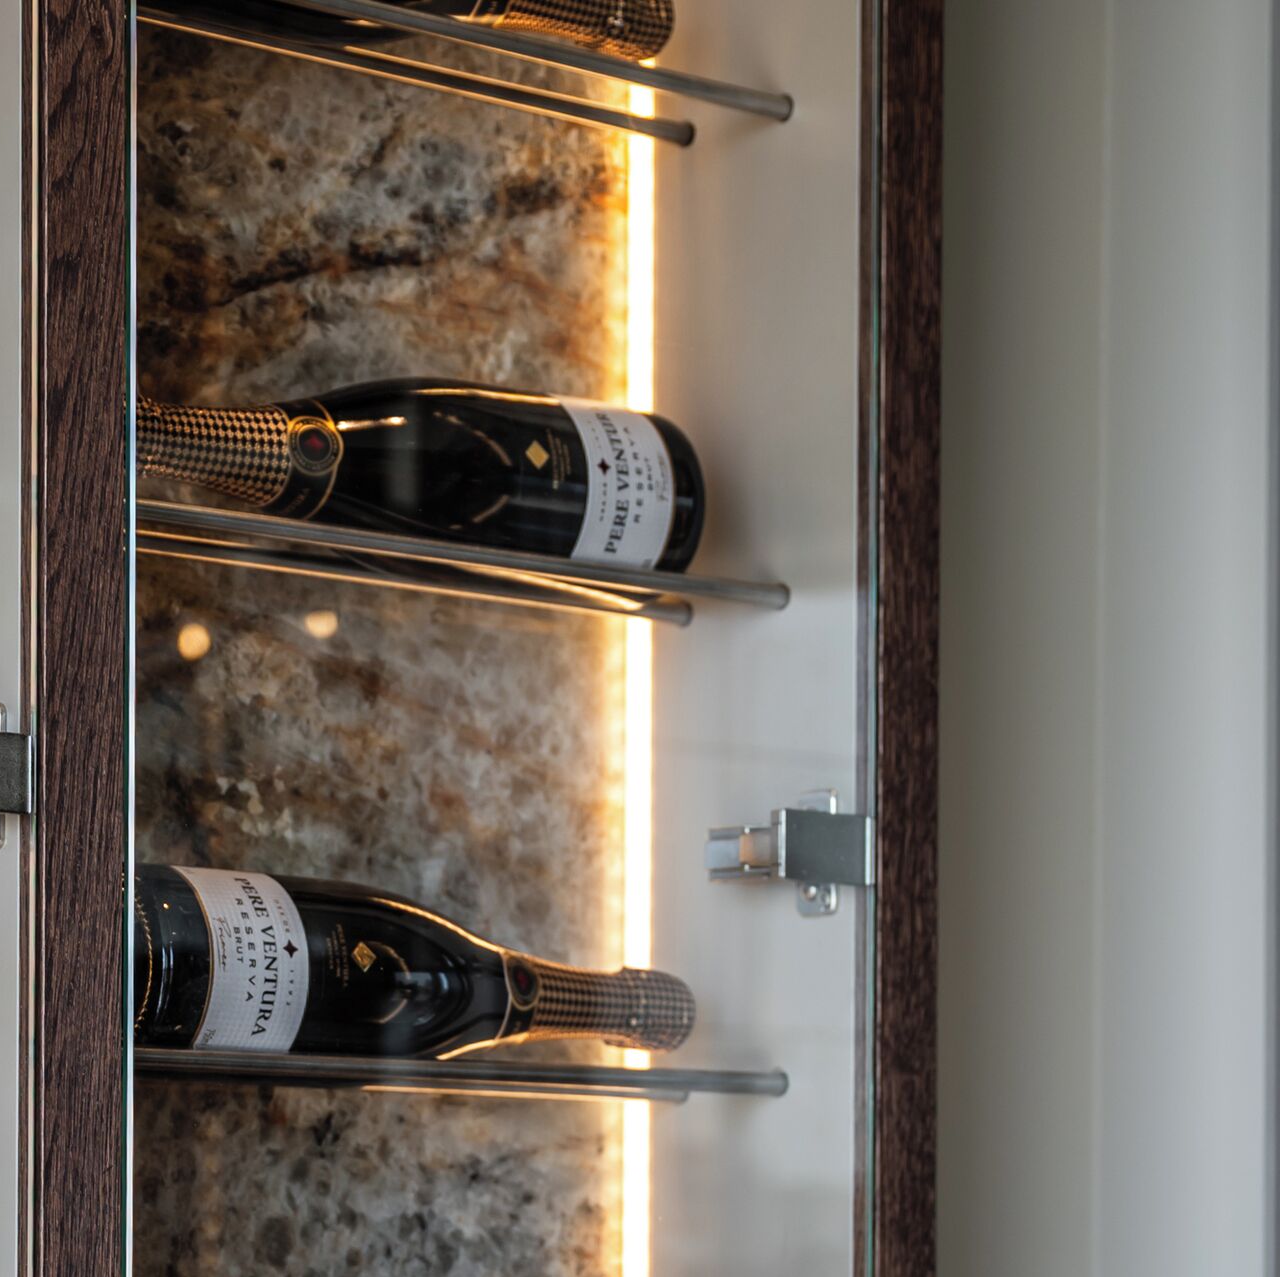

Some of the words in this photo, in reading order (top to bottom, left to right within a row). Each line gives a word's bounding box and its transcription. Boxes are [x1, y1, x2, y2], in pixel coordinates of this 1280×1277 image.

[596, 412, 629, 492] VENTUR
[604, 500, 629, 554] PERE
[234, 877, 270, 918] PERE
[233, 926, 245, 964] BRUT
[235, 897, 257, 1002] RESERVA
[251, 925, 280, 1036] VENTURA
